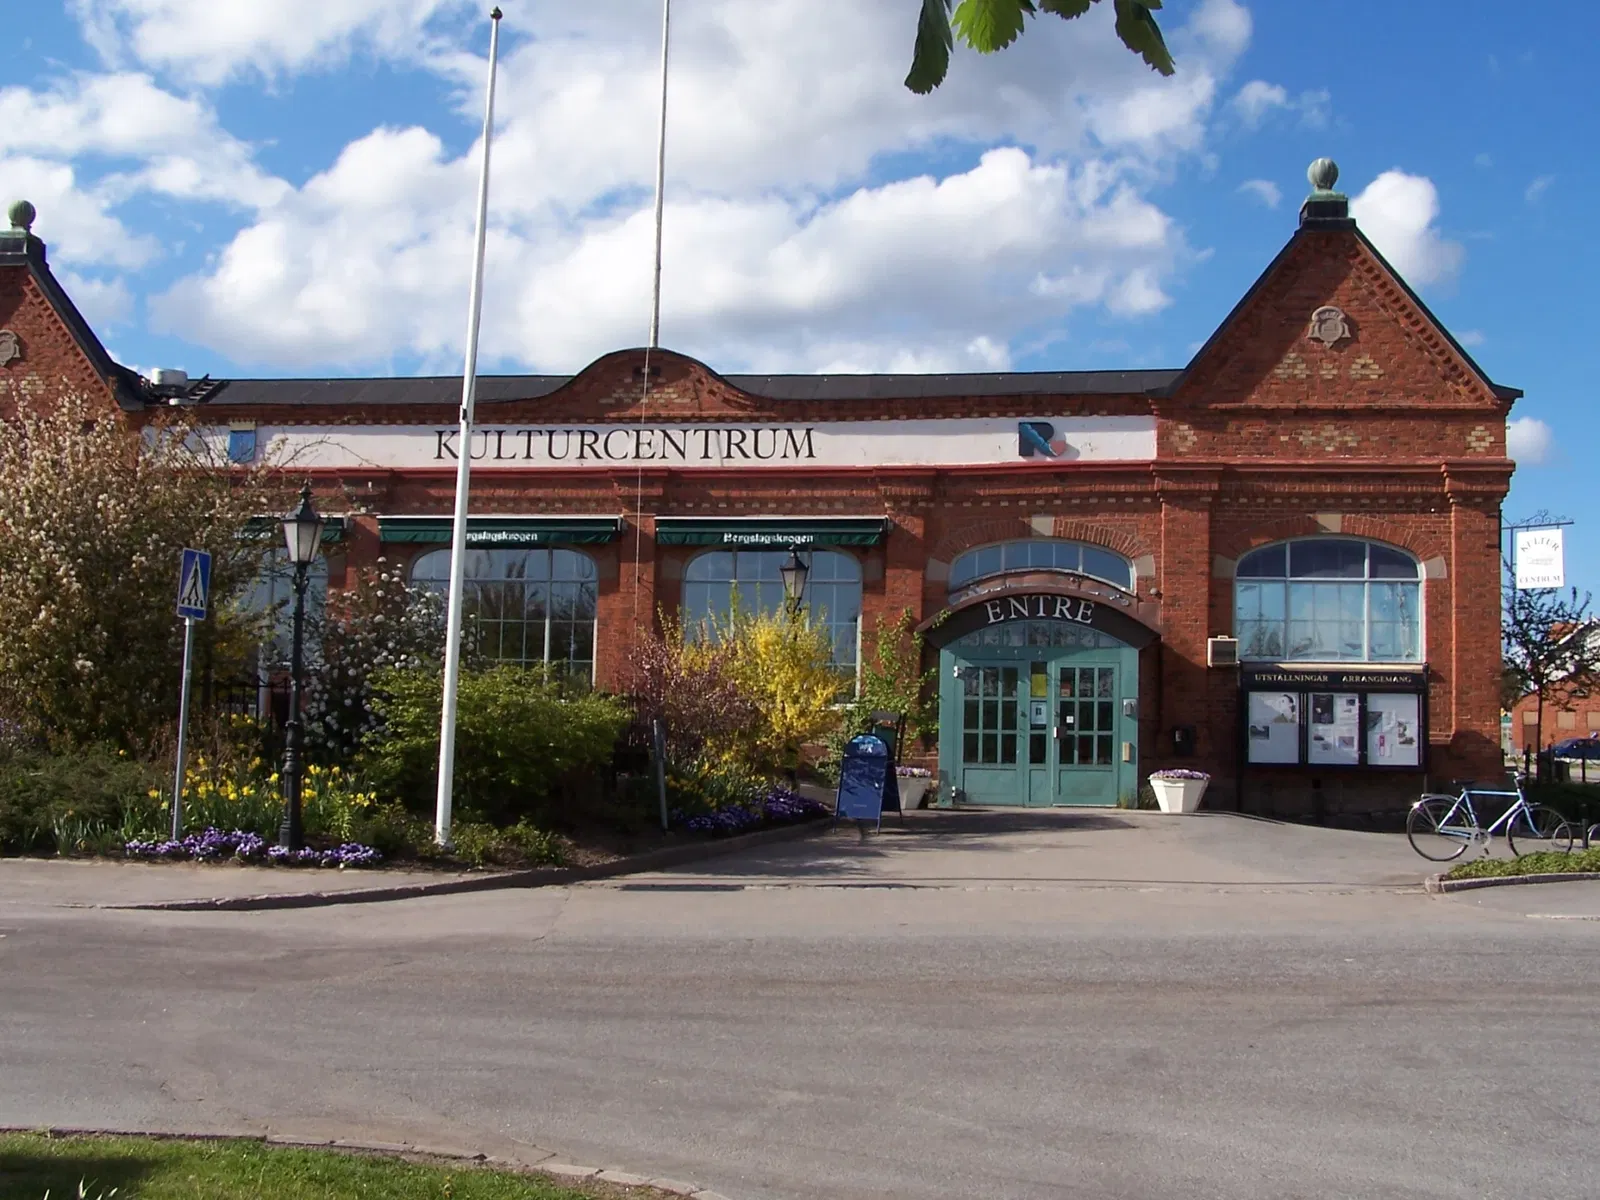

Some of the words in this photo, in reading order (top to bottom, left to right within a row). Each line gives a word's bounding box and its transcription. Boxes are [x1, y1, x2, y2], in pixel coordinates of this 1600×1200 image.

[433, 427, 816, 460] KULTURCENTRUM
[466, 531, 538, 542] rgslagskrogen
[723, 532, 814, 544] Bergslagskrogen
[984, 595, 1095, 624] ENTRE
[1342, 675, 1412, 683] ARRANGEMANG
